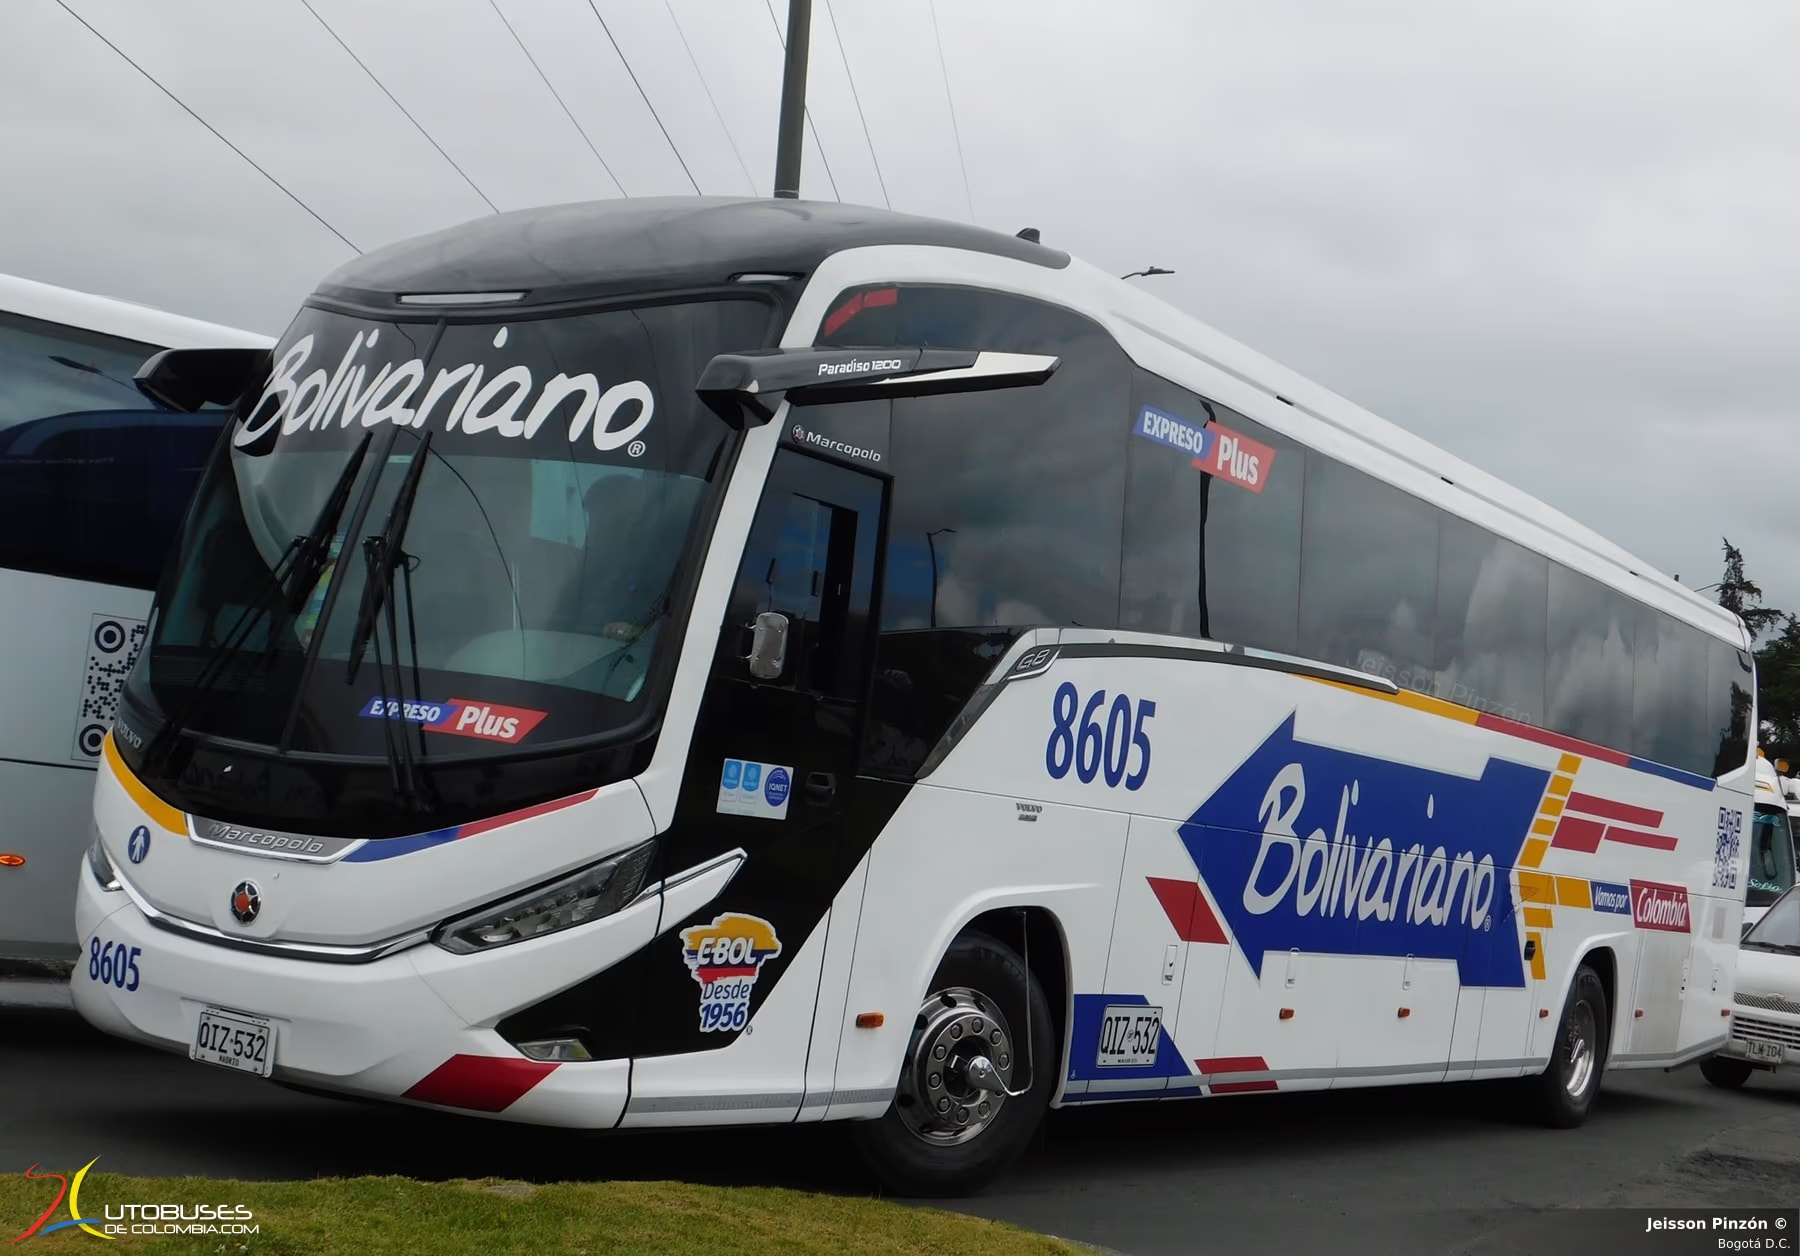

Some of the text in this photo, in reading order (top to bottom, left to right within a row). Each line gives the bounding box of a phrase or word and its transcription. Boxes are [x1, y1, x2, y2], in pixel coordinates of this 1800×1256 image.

[818, 358, 902, 376] Paradiso 1200
[806, 431, 881, 462] Marcopolo
[1143, 411, 1259, 485] EXPRESO Plus
[456, 705, 519, 739] Plus
[1046, 681, 1156, 791] 8605
[768, 783, 788, 792] IQNET
[207, 823, 324, 853] Marcopolo
[1594, 886, 1628, 912] Vamos por
[1636, 887, 1687, 927] Colombia
[90, 936, 142, 992] 8605
[703, 979, 750, 1000] Desde
[701, 1002, 746, 1028] 1956
[219, 1055, 239, 1067] MADRID
